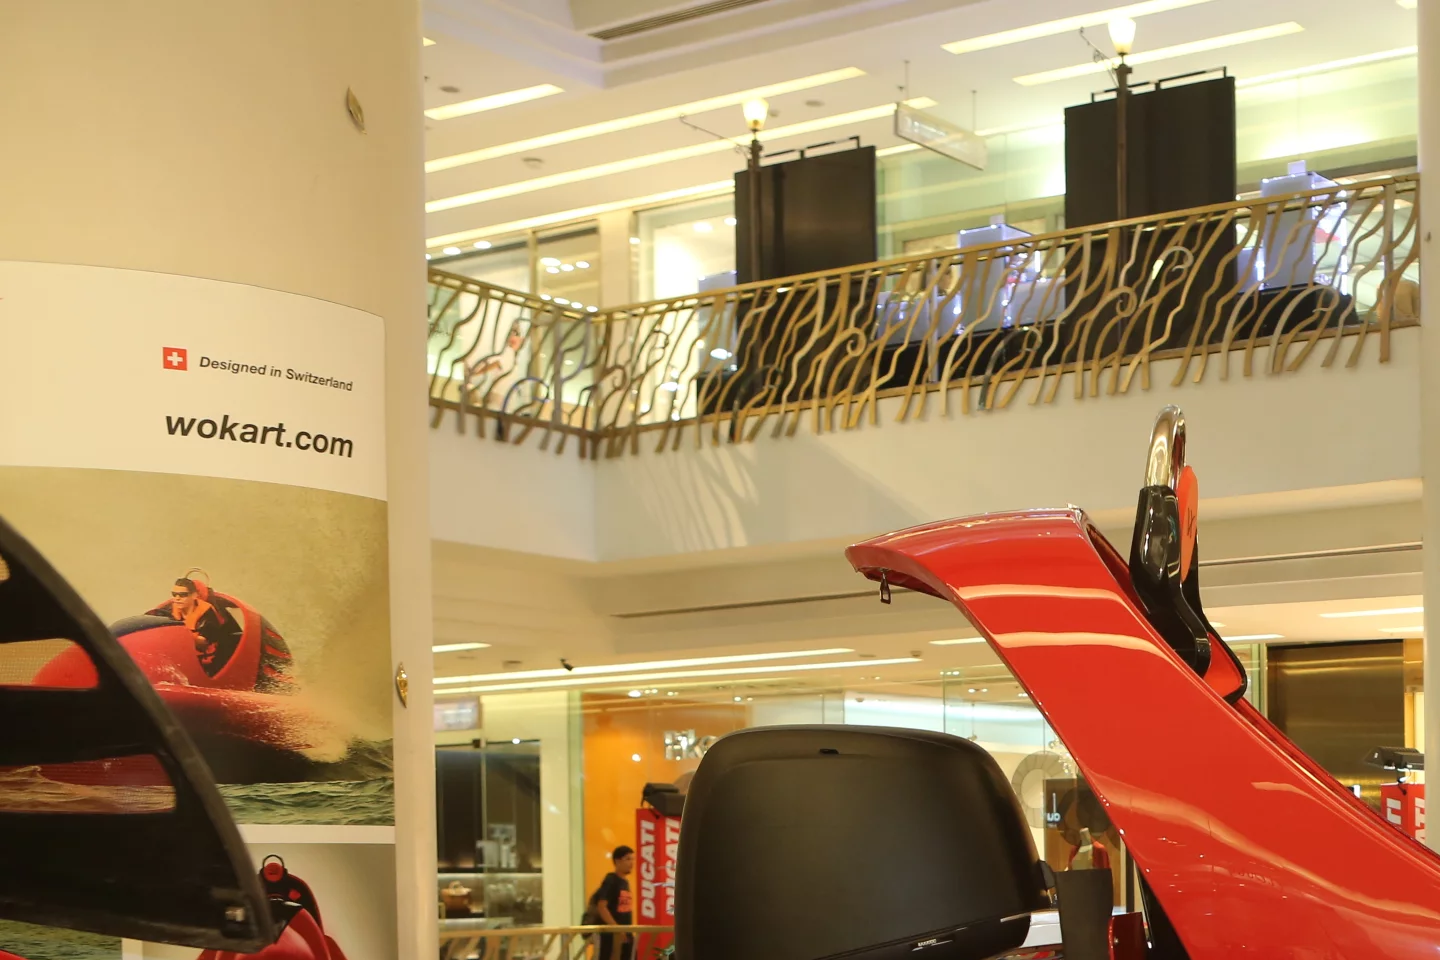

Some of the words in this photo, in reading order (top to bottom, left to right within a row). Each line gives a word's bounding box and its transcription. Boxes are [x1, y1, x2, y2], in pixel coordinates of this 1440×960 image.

[199, 356, 267, 375] Designed
[270, 365, 282, 378] in
[286, 368, 354, 392] Switzerland
[165, 414, 354, 458] wokart.com
[640, 819, 656, 919] DUCATI
